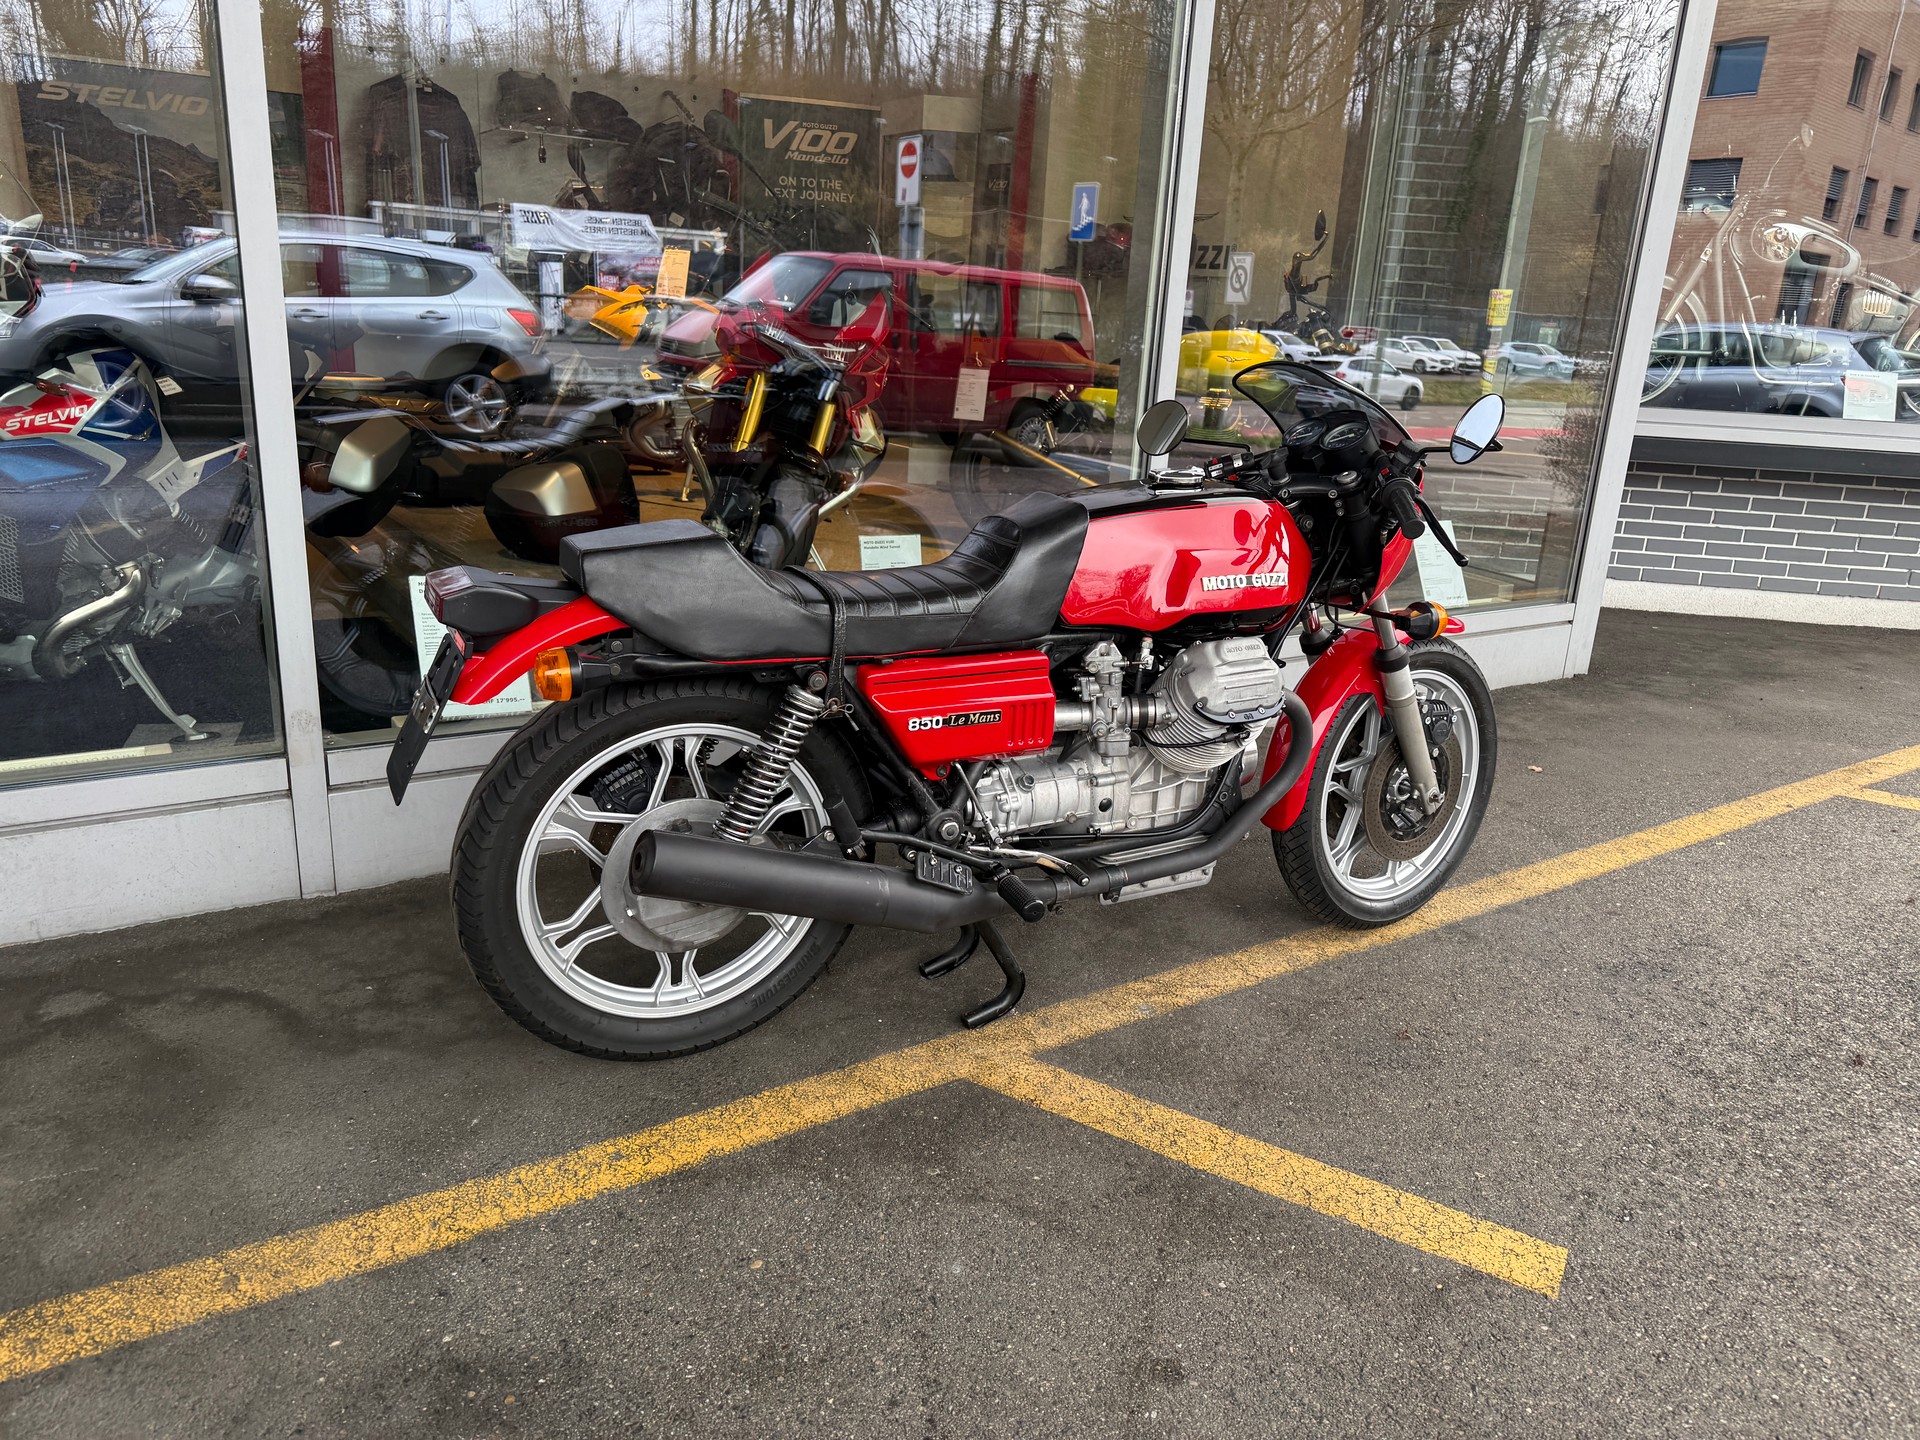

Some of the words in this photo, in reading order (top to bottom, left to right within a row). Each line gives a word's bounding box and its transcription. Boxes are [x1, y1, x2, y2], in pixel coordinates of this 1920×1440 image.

[37, 80, 210, 116] STELVIO
[802, 121, 819, 129] MOTO
[763, 118, 858, 155] V100
[784, 150, 849, 165] Mandello
[778, 175, 797, 187] ON
[800, 177, 816, 188] TO
[820, 179, 842, 190] THE
[764, 187, 797, 198] NEXT
[800, 190, 855, 203] JOURNEY
[5, 404, 88, 431] STELVIO
[1202, 574, 1247, 591] MOTO
[1251, 572, 1288, 588] GUZZI
[908, 716, 943, 731] 850
[950, 715, 965, 726] Le
[968, 712, 1001, 724] Mans
